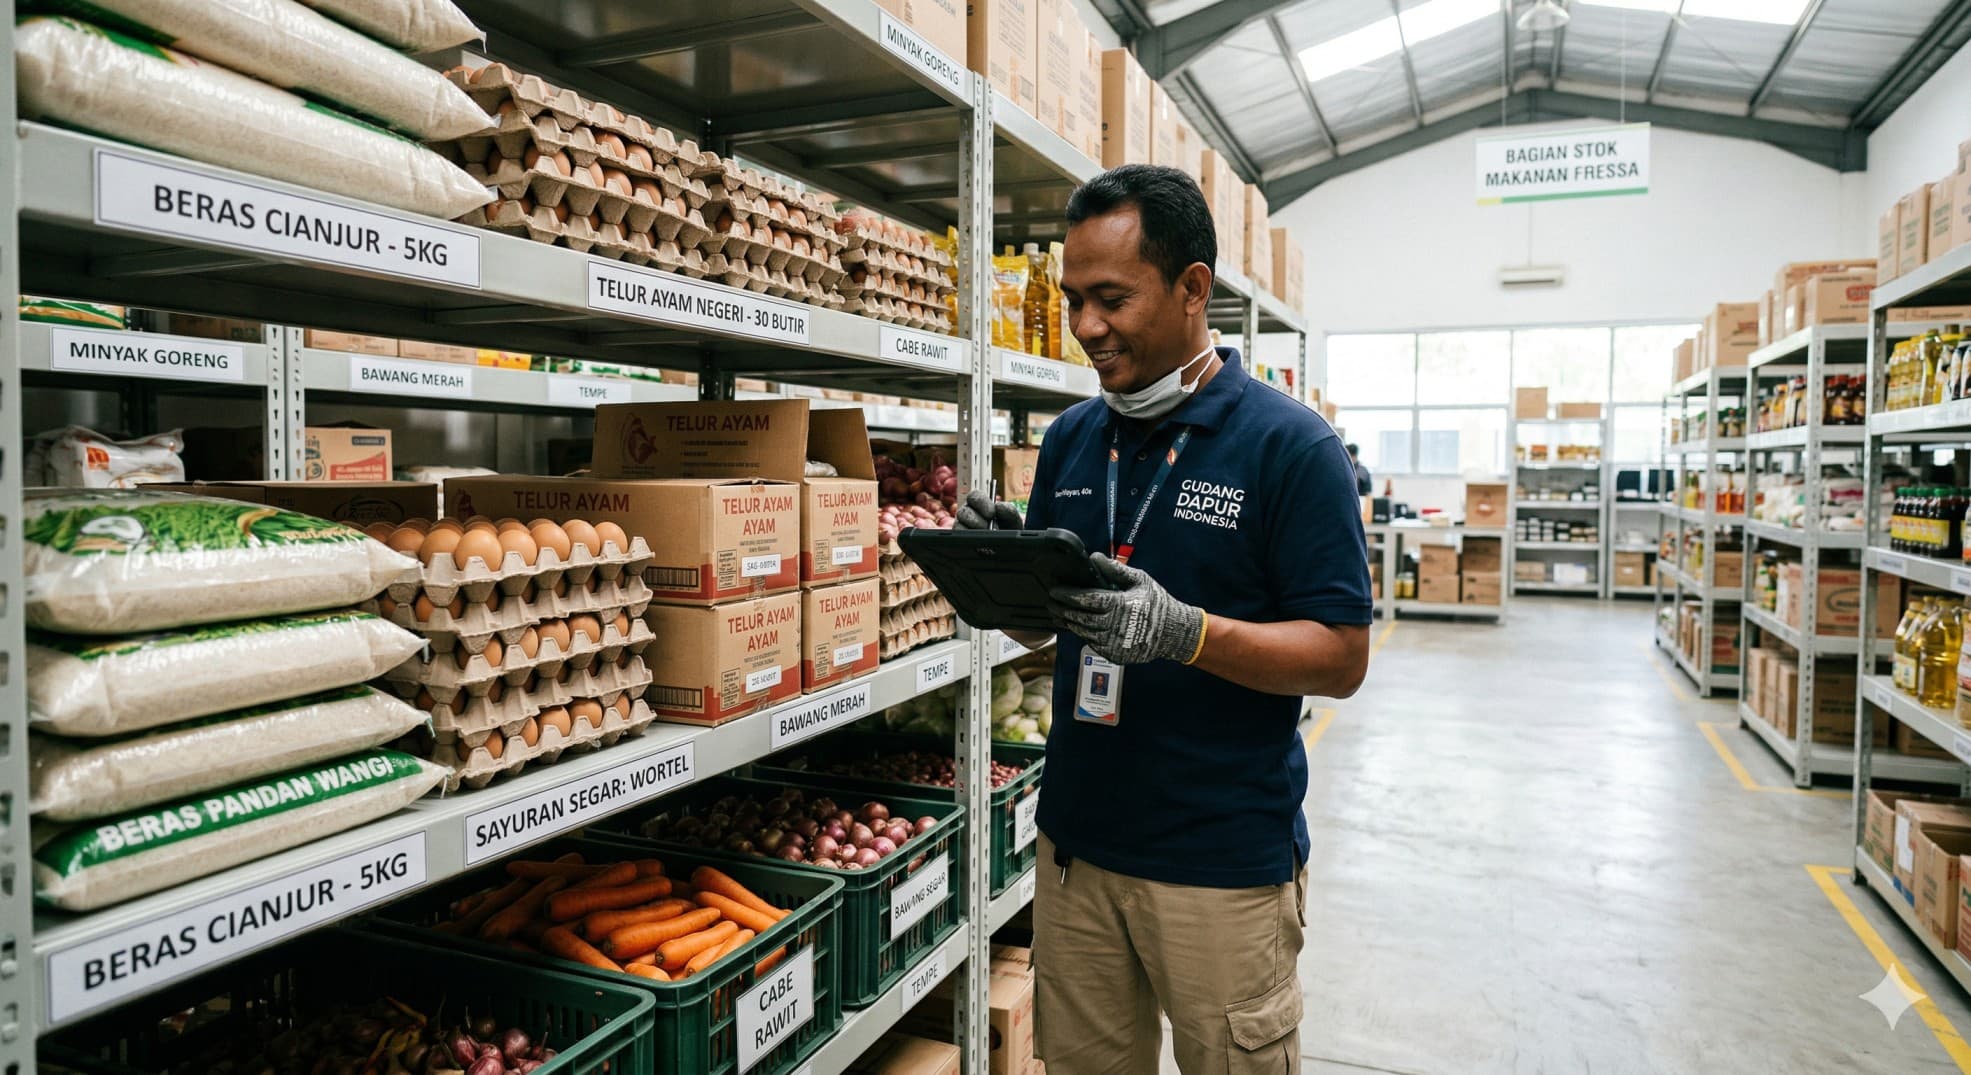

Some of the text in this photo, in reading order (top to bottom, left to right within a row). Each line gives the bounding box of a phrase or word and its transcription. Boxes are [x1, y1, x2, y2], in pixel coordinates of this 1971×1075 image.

[887, 24, 959, 86] MINYAK GORENG
[1506, 141, 1617, 164] BAGIAN STOK
[1485, 162, 1639, 187] MAKANAN FRESSA
[154, 184, 255, 230] BERAS
[265, 209, 381, 255] CIANJUR
[403, 237, 449, 267] 5KG
[597, 276, 647, 306] TELUR
[651, 289, 693, 314] AYAM
[696, 297, 744, 323] NEGERI
[754, 309, 769, 328] 30
[772, 313, 805, 335] BUTIR
[70, 341, 229, 371] MINYAK GORENG
[896, 338, 948, 361] CABE RAWIT
[361, 367, 464, 388] BAWANG MERAH
[579, 386, 608, 399] TEMPE
[666, 414, 770, 432] TELUR AYAM
[513, 490, 629, 513] TELUR AYAM
[817, 492, 872, 508] TELUR AYAM
[1181, 479, 1245, 501] GUDANG
[722, 496, 793, 515] TELUR AYAM
[1176, 492, 1241, 518] DAPUR
[743, 518, 776, 535] AYAM
[833, 511, 858, 527] AYAM
[1173, 507, 1238, 530] INDONESIA
[819, 590, 873, 614] TELUR AYAM
[728, 606, 795, 634] TELUR AYAM
[834, 611, 860, 630] AYAM
[747, 630, 778, 652] AYAM
[923, 661, 949, 684] TEMPE
[780, 691, 865, 737] BAWANG MERAH
[97, 756, 394, 852] BERAS PANDAN WANGI
[475, 754, 690, 848] SAYURAN SEGAR: WORTEL
[895, 888, 925, 919] BAWANG
[83, 925, 197, 992] BERAS
[207, 879, 335, 944] CIANJUR
[360, 852, 409, 890] 5KG
[759, 971, 794, 1012] CABE
[911, 963, 939, 998] TEMPE
[755, 998, 798, 1050] RAWIT
